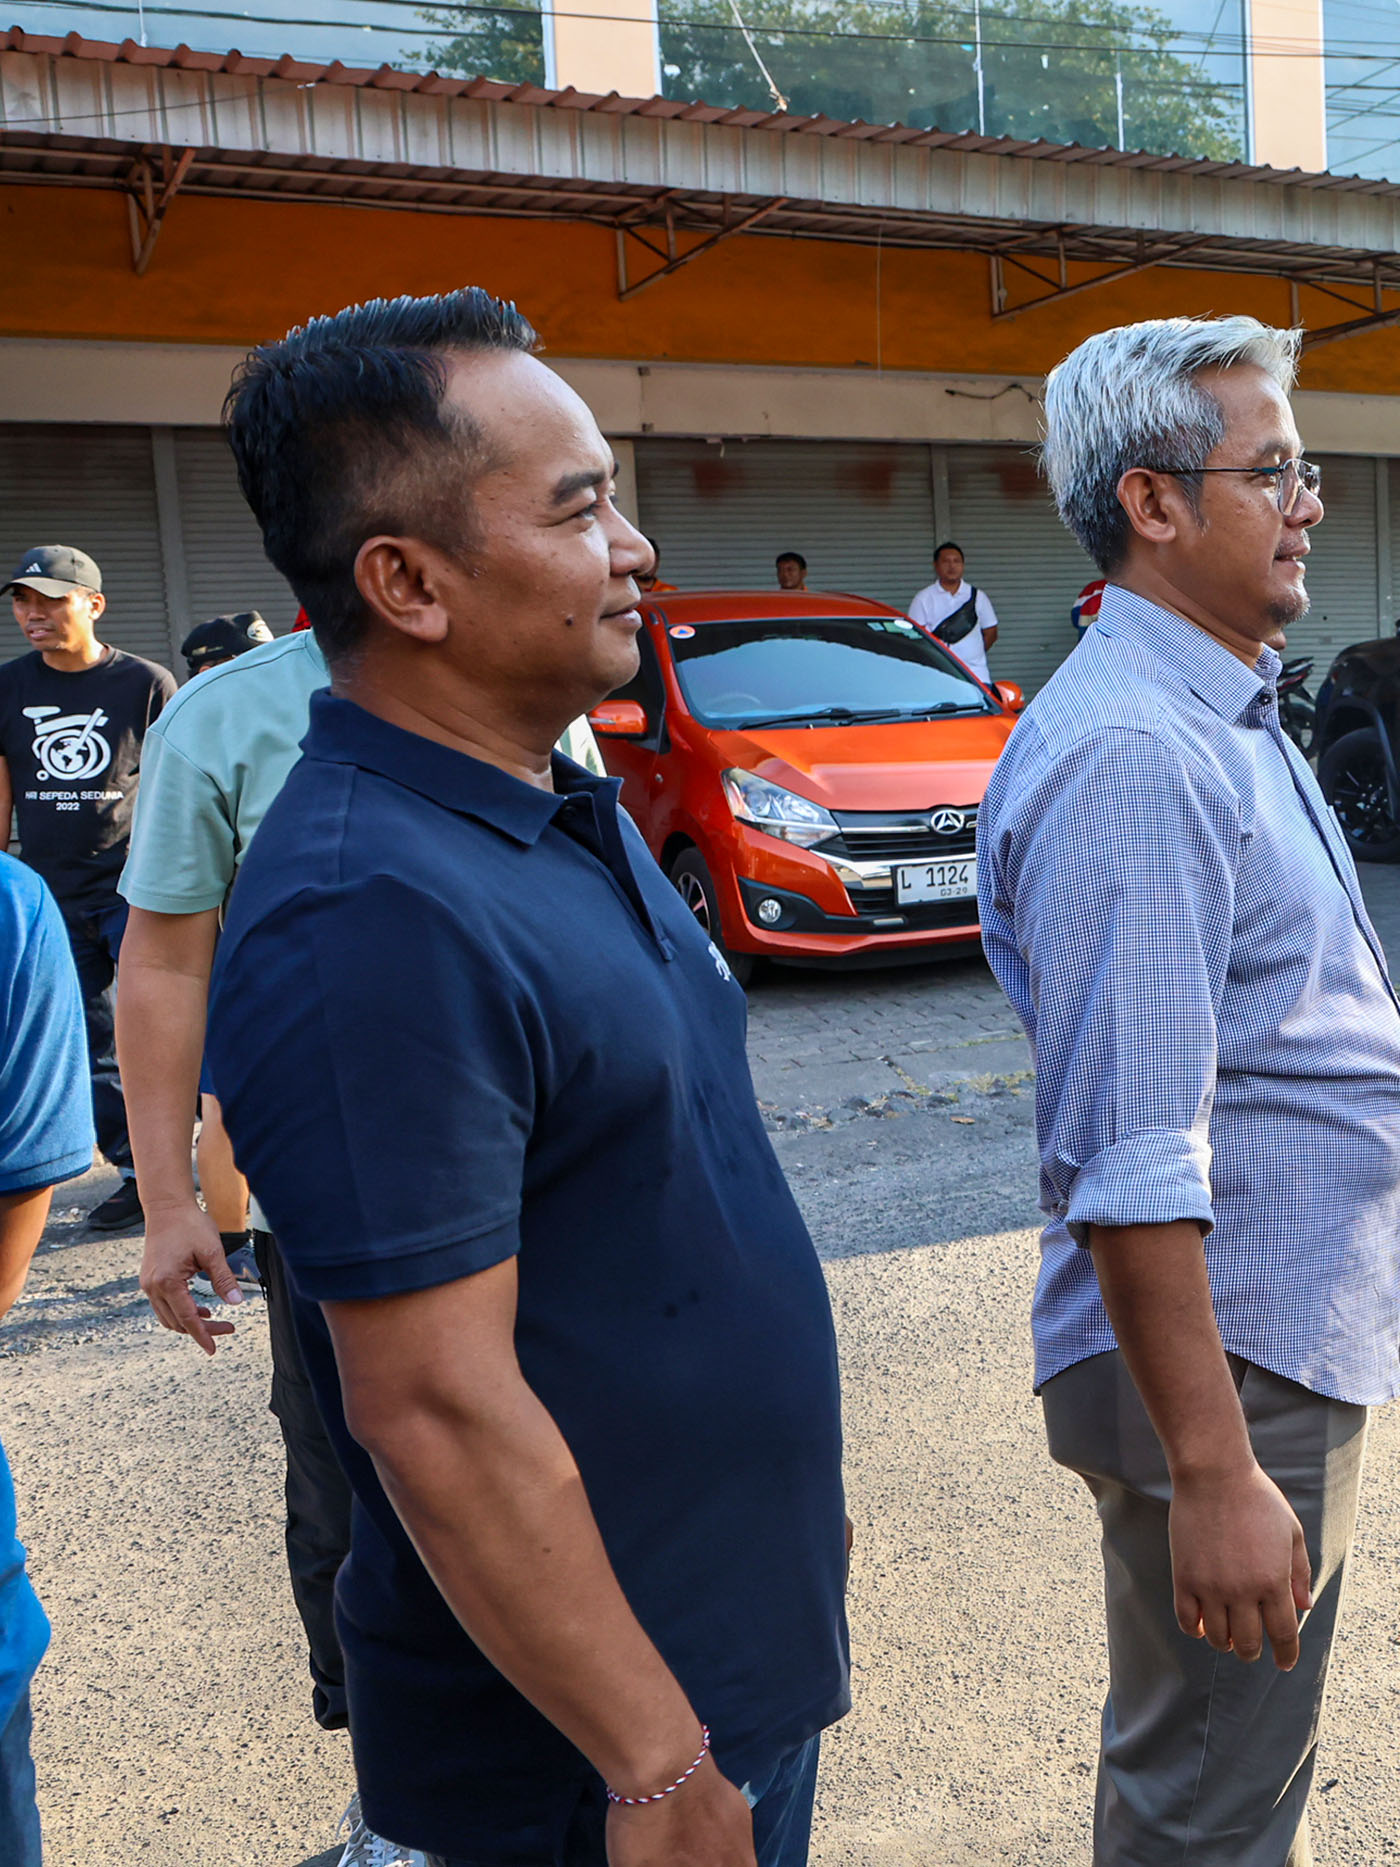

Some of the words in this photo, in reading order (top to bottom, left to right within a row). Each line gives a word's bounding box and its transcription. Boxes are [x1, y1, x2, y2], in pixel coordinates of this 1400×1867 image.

[39, 791, 78, 800] SEPEDA
[55, 801, 80, 811] 2022
[901, 869, 912, 890] L
[926, 864, 969, 887] 1124
